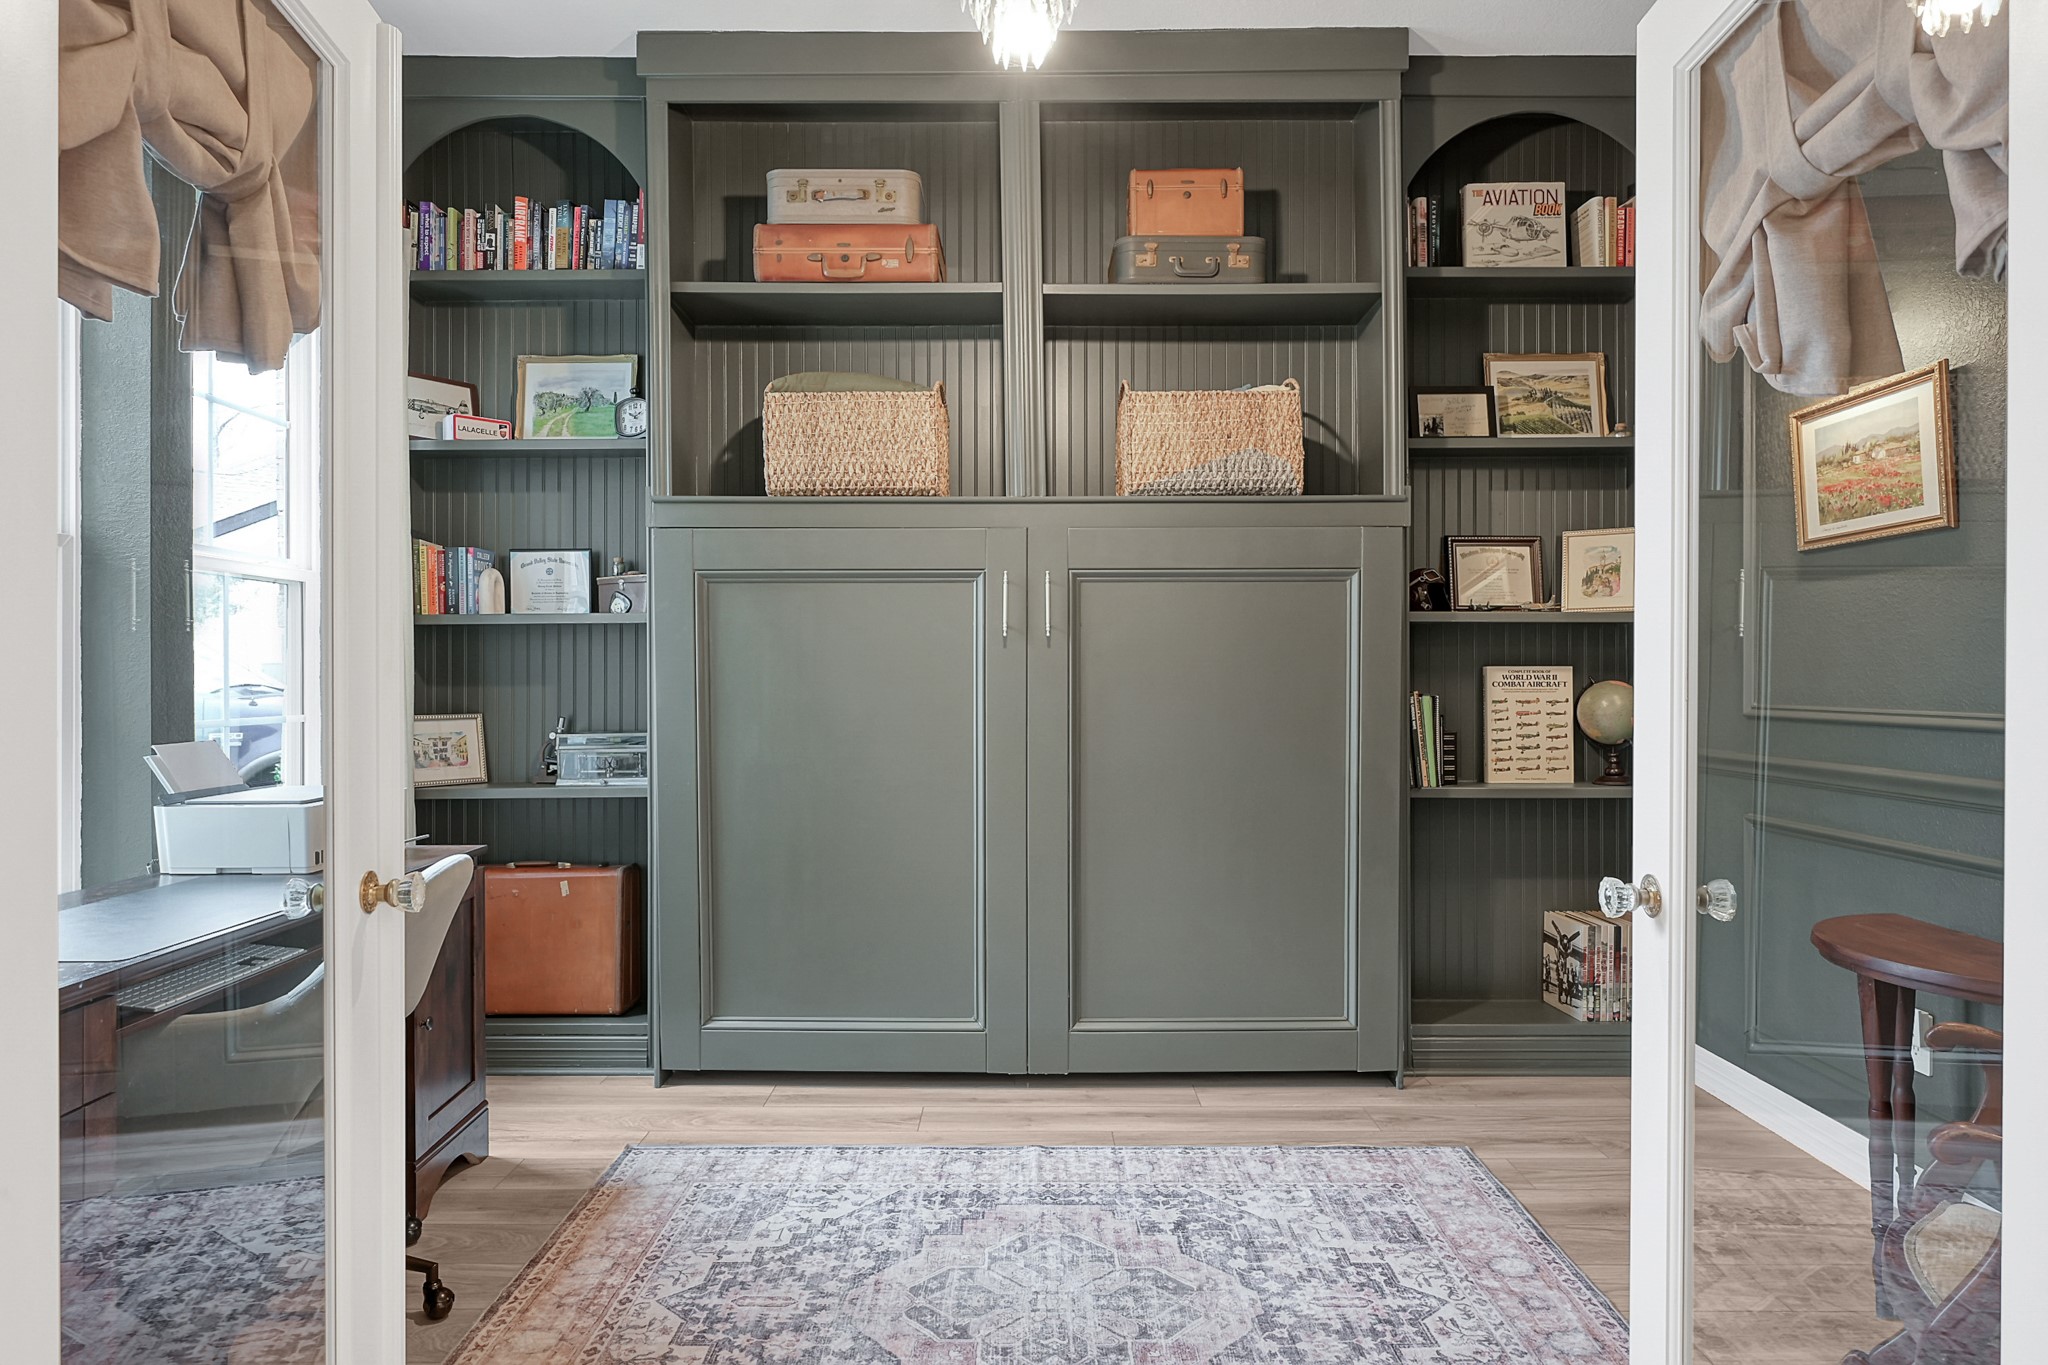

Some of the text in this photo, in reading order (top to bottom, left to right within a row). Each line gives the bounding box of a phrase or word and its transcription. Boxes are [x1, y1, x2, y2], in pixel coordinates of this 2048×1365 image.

[1482, 189, 1558, 206] AVIATION
[1533, 203, 1563, 216] BOOK
[515, 201, 526, 242] AIRFRAME
[458, 425, 498, 436] LALACELLE
